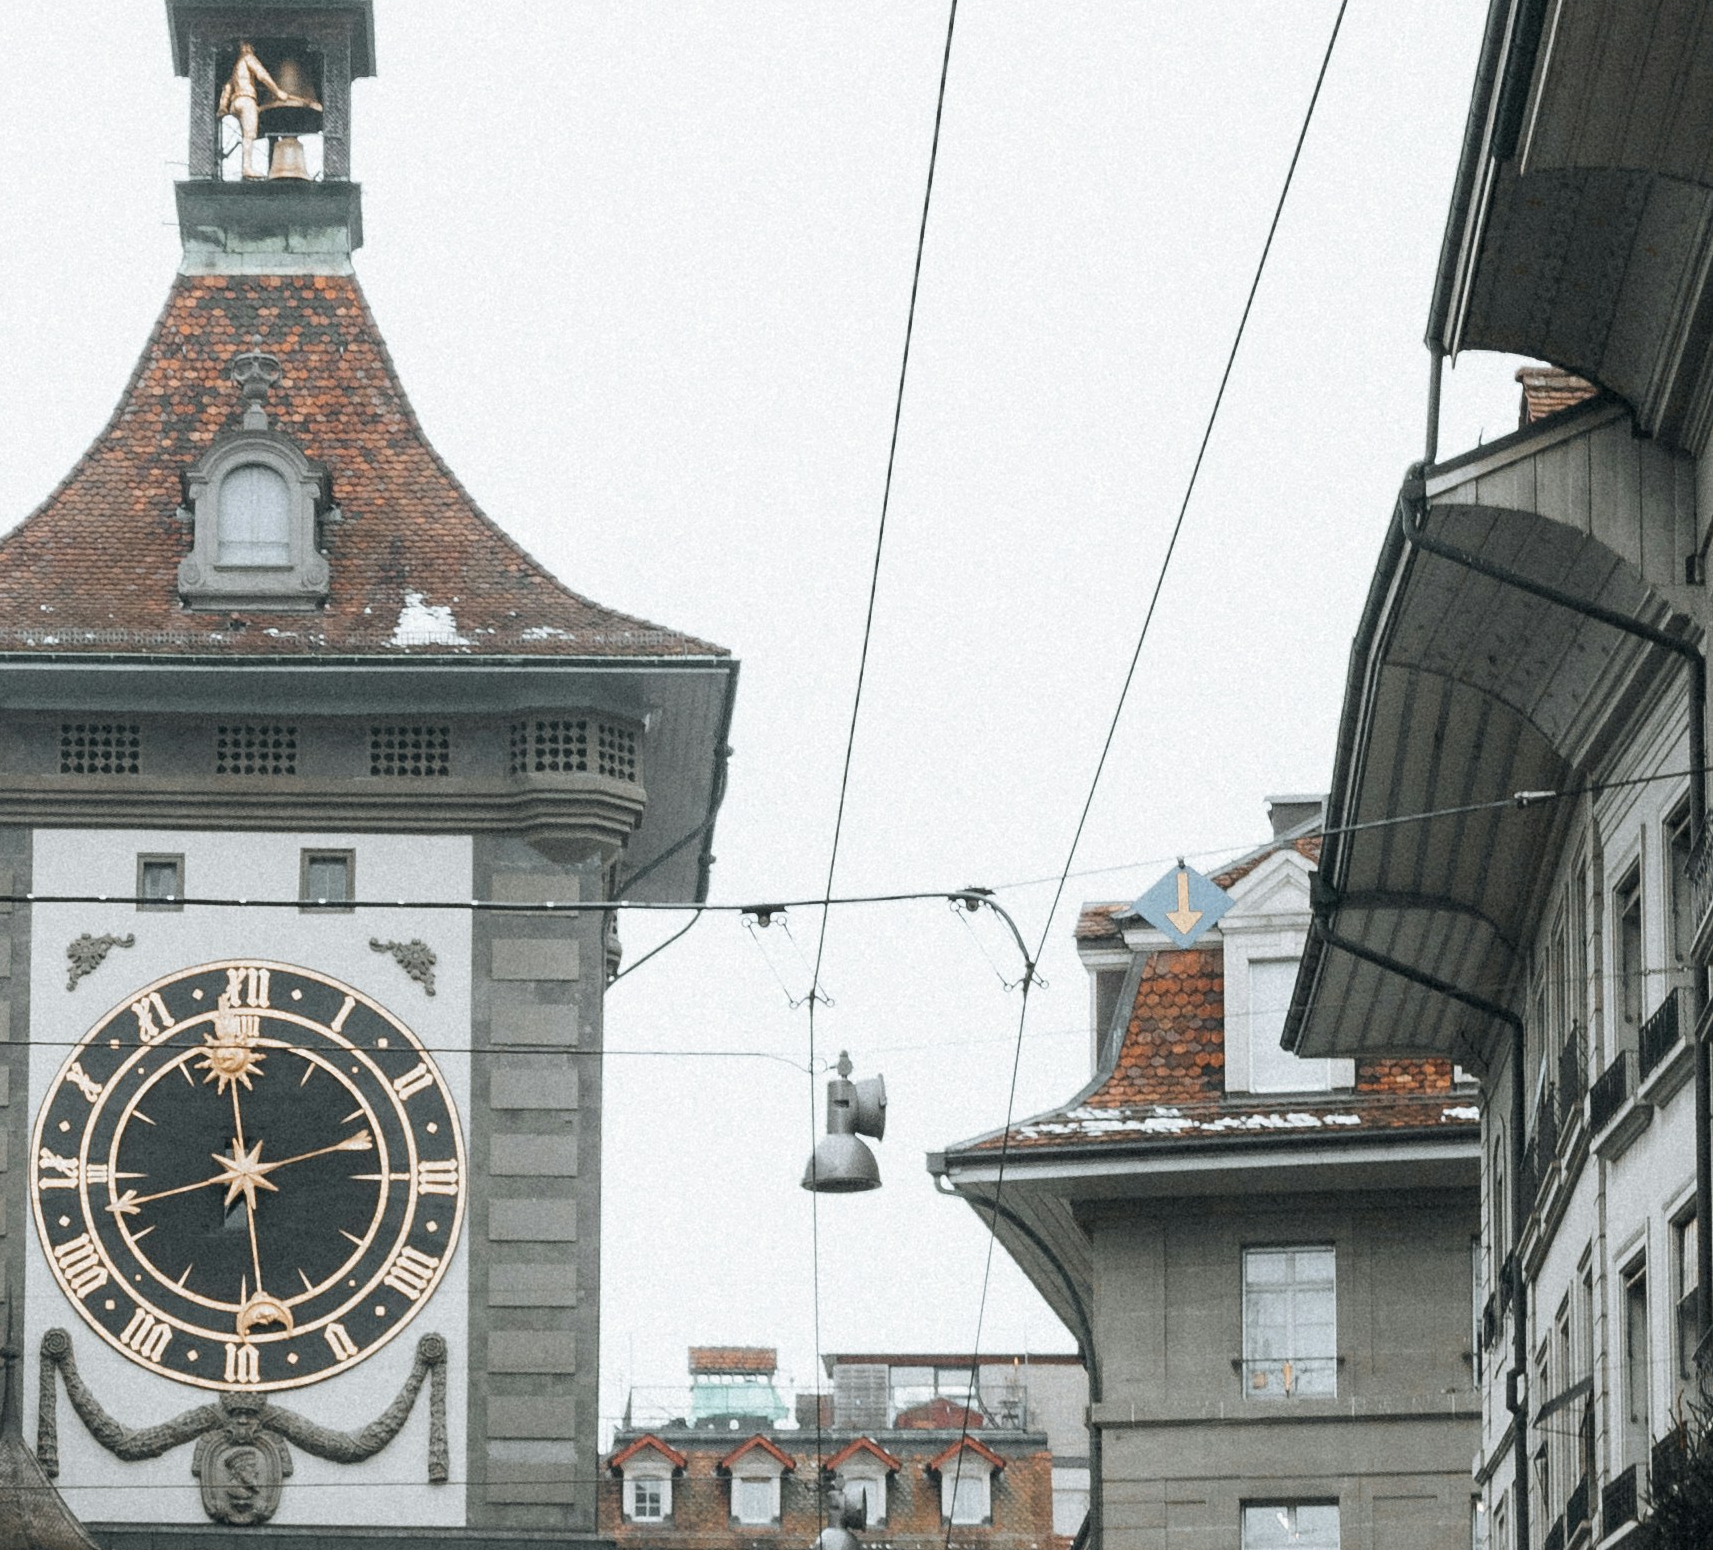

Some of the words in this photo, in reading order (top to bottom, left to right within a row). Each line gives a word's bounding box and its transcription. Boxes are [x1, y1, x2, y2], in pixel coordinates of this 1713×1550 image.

[131, 992, 175, 1042] XI
[331, 995, 355, 1032] I
[66, 1061, 103, 1103] X
[393, 1062, 434, 1101] II
[39, 1147, 79, 1190] IX
[418, 1158, 459, 1196] III
